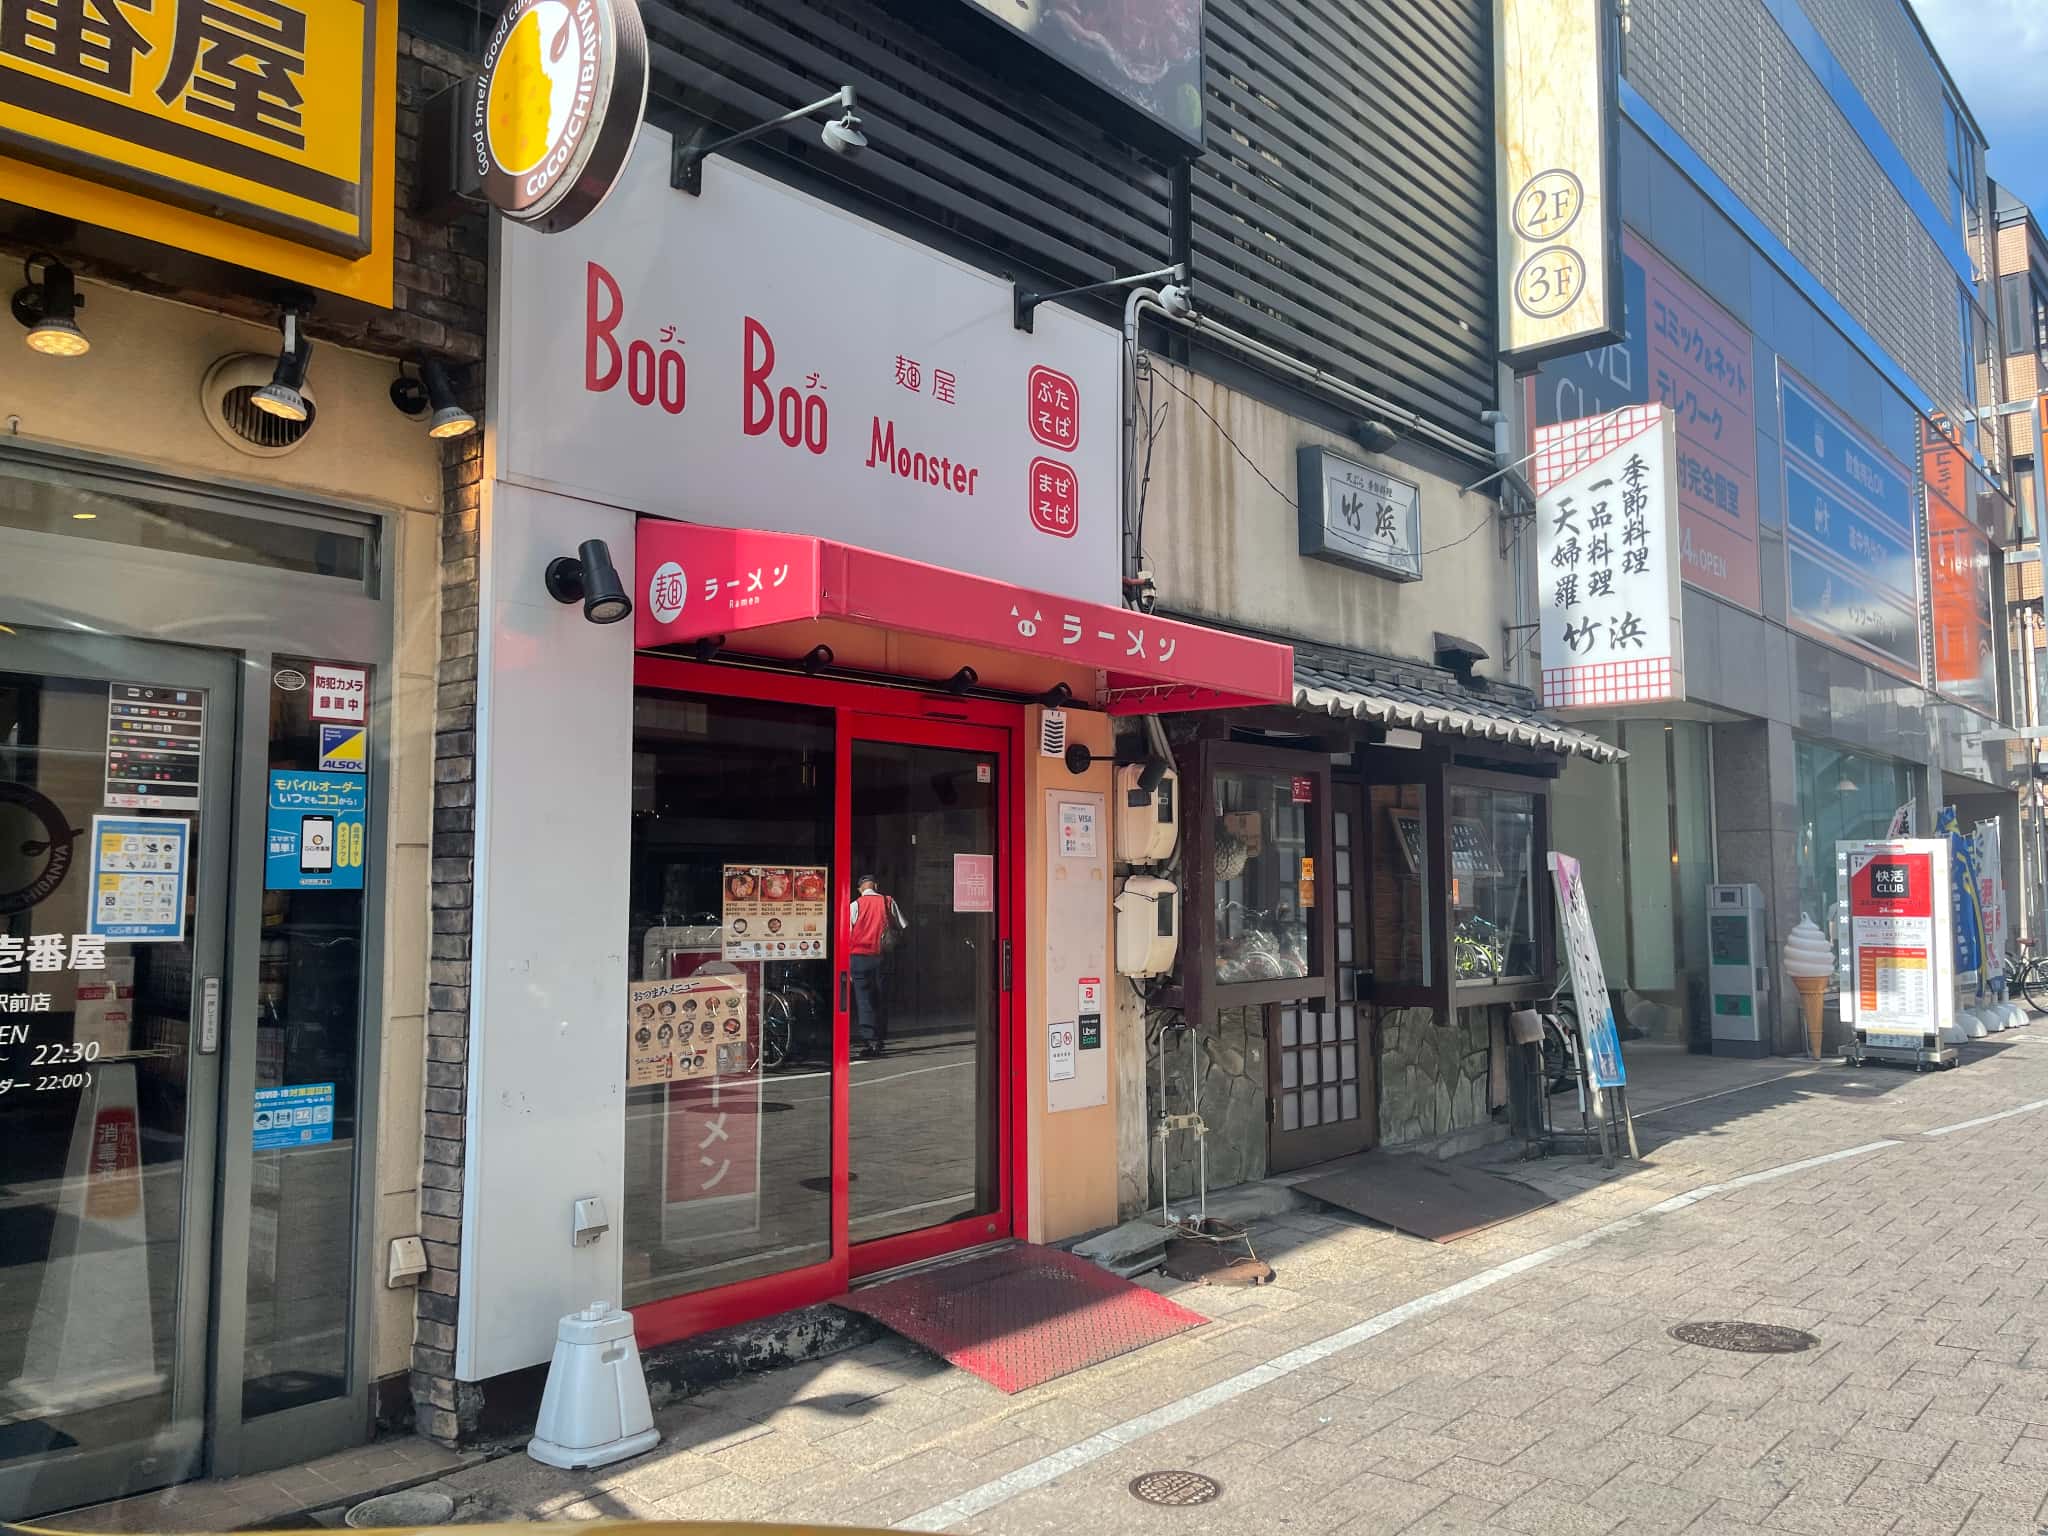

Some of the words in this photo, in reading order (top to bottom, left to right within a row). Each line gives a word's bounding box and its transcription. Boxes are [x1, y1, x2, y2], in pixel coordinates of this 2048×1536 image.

[484, 16, 508, 69] Good
[475, 74, 489, 127] smell.
[473, 131, 490, 176] Good
[1526, 189, 1571, 227] 2F
[1529, 265, 1573, 303] 3F
[659, 324, 686, 344] ブー
[585, 260, 686, 414] Boo
[743, 315, 828, 455] Boo
[806, 372, 828, 390] ブー
[1037, 380, 1071, 411] ぶた
[1038, 410, 1071, 438] そば
[865, 415, 979, 496] Monster
[1039, 472, 1071, 499] まぜ
[1039, 499, 1071, 525] そば
[1619, 453, 1652, 575] 季節料理
[1587, 478, 1616, 597] 一品料理
[1550, 496, 1582, 610] 天婦羅
[1701, 548, 1728, 578] OPEN
[656, 572, 682, 613] 麺
[704, 564, 789, 601] ラーメン
[729, 596, 760, 609] Ramen
[1062, 613, 1176, 662] ラーメン
[1562, 611, 1648, 655] 竹浜
[315, 676, 363, 691] 防犯カメラ
[322, 760, 364, 770] ALSOK
[274, 779, 362, 793] モバイルオーダー
[1079, 815, 1092, 823] VISA
[1876, 870, 1904, 883] 快活
[1876, 884, 1904, 893] CLUB
[1083, 1027, 1097, 1036] Uber
[30, 1041, 101, 1066] 22:30
